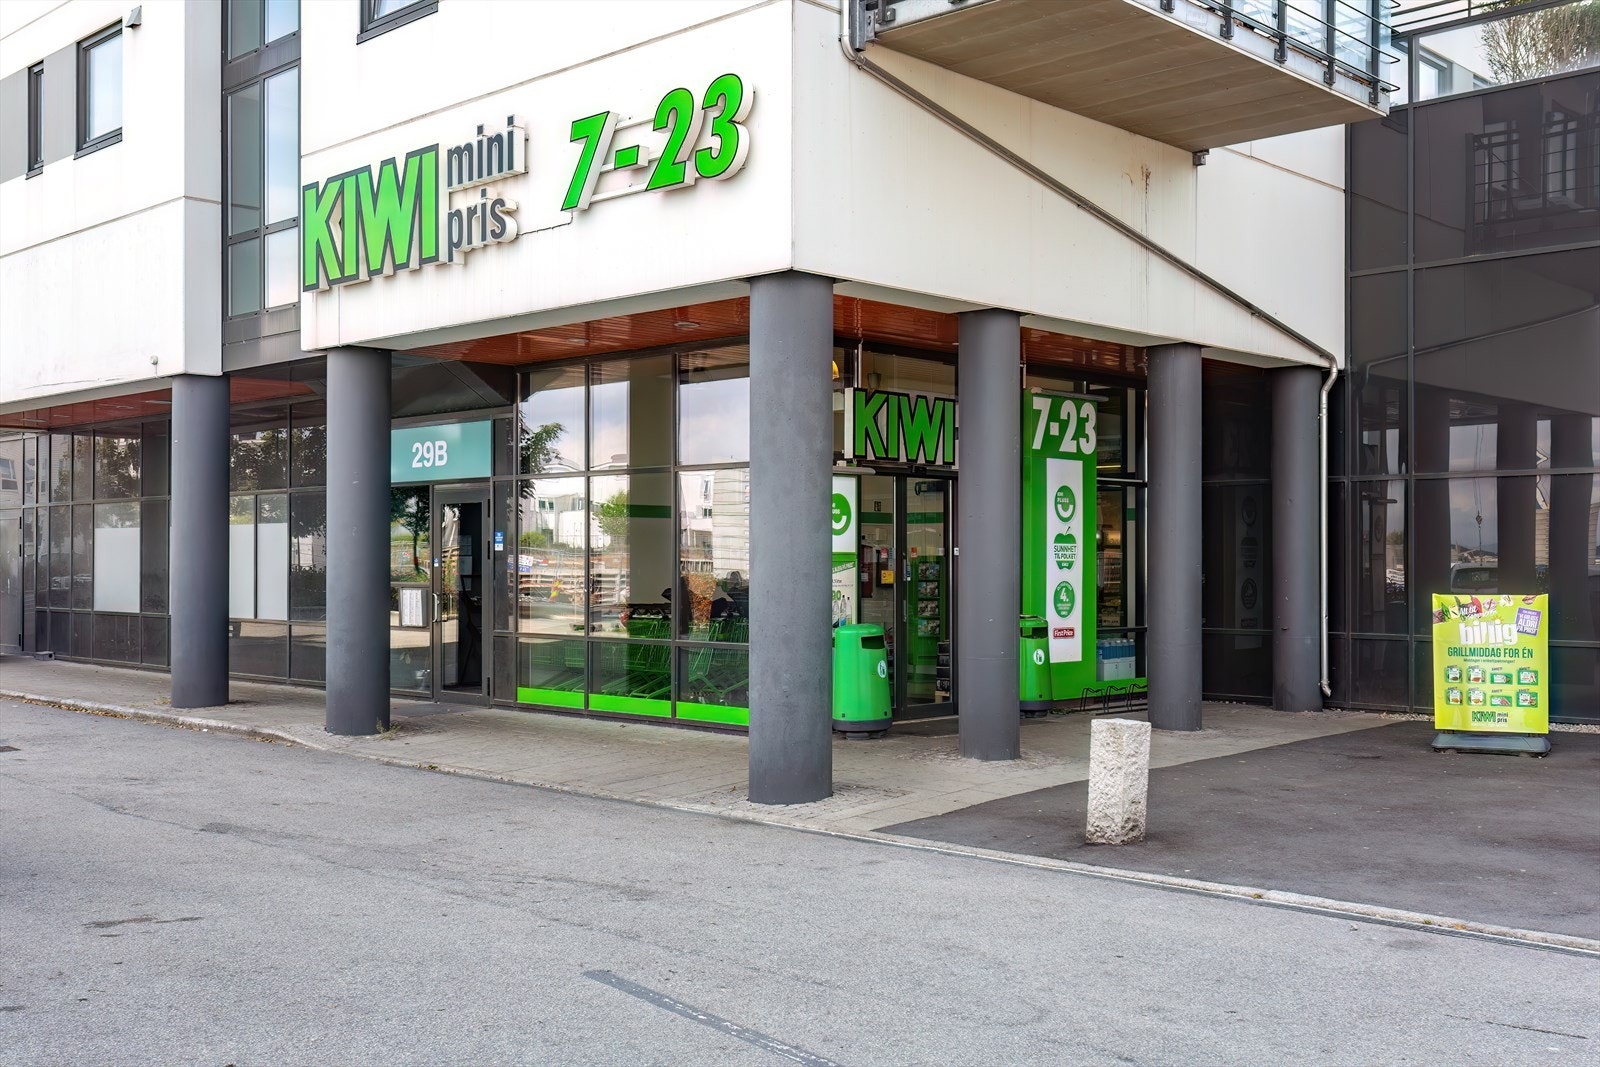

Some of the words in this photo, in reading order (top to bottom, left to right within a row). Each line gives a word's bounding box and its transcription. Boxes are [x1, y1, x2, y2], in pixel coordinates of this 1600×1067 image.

[447, 115, 514, 188] mini
[561, 73, 744, 211] 7-23
[302, 143, 440, 293] KIWI
[447, 188, 507, 263] pris
[853, 387, 956, 466] KIWI
[1032, 396, 1097, 455] 7-23
[412, 440, 448, 468] 29B
[1053, 545, 1077, 553] SUNNHET
[1458, 619, 1518, 647] billig
[1517, 619, 1538, 629] ALDRI
[1447, 647, 1501, 658] GRILLMIDDAG
[1503, 648, 1519, 658] FOR
[1522, 646, 1533, 659] ÉN
[1472, 710, 1496, 722] KIWI
